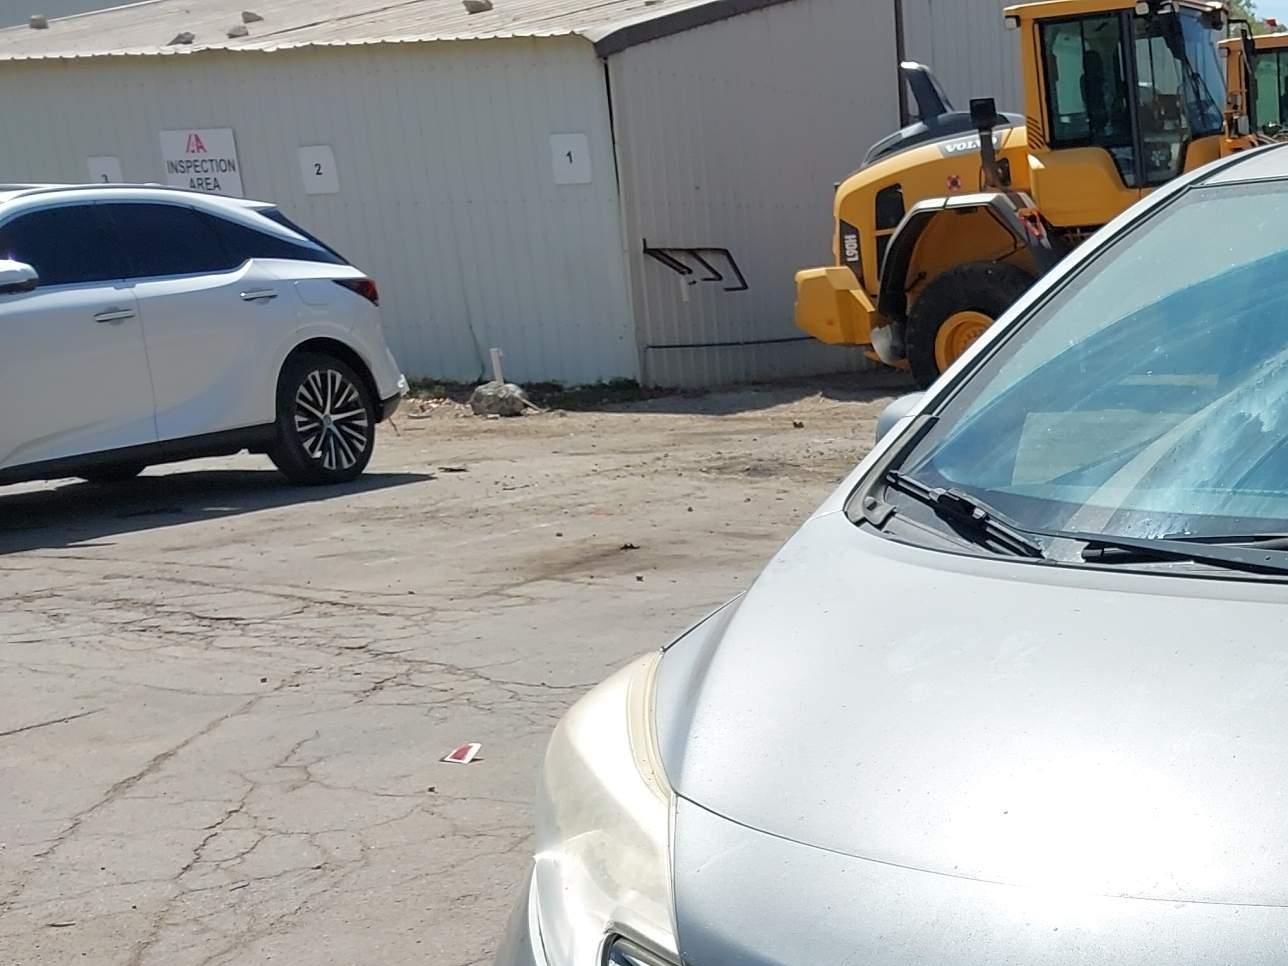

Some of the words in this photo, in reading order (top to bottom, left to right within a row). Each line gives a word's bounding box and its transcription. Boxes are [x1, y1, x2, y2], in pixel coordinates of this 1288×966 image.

[566, 150, 573, 164] 1
[166, 158, 236, 174] INSPECTION
[314, 162, 323, 176] 2
[189, 176, 221, 191] AREA
[844, 234, 859, 262] L90H
